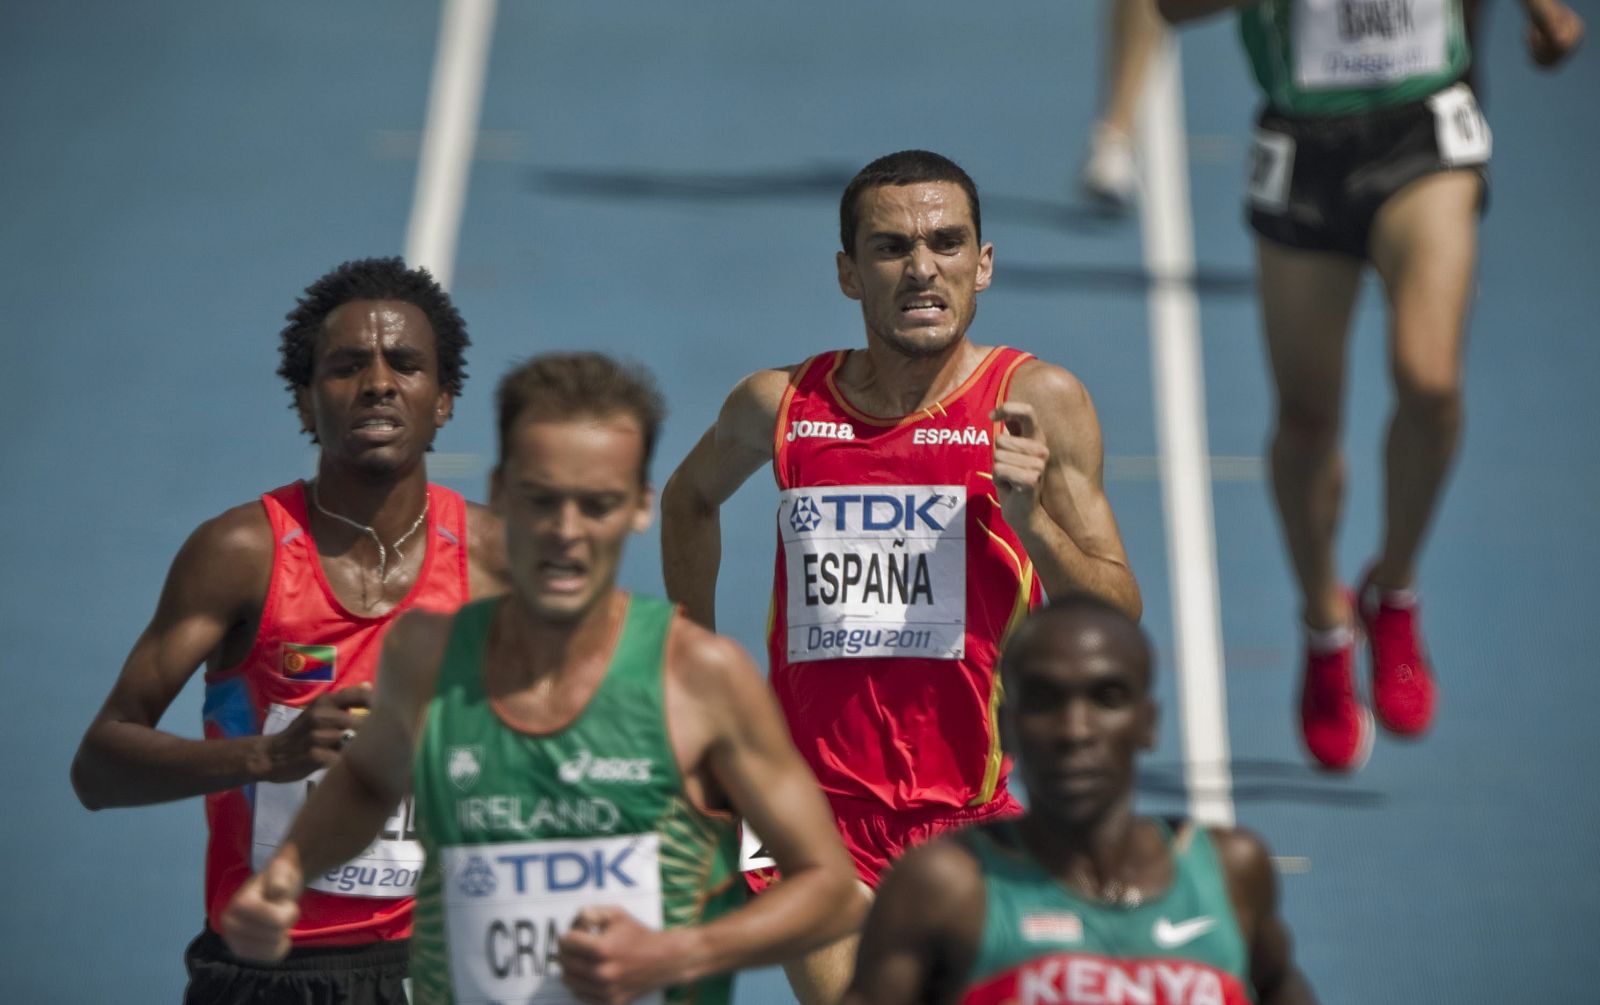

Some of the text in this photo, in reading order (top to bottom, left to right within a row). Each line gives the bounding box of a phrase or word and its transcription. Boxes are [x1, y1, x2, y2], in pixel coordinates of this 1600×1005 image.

[912, 426, 991, 446] ESPAÑA
[821, 494, 947, 532] TDK
[803, 538, 934, 606] ESPAÑA
[807, 626, 931, 654] Daegu 2011
[460, 797, 620, 832] IRELAND
[324, 865, 418, 891] egu 201
[497, 847, 637, 892] TDK
[487, 918, 562, 979] CRA
[1019, 957, 1225, 1005] KENYA
